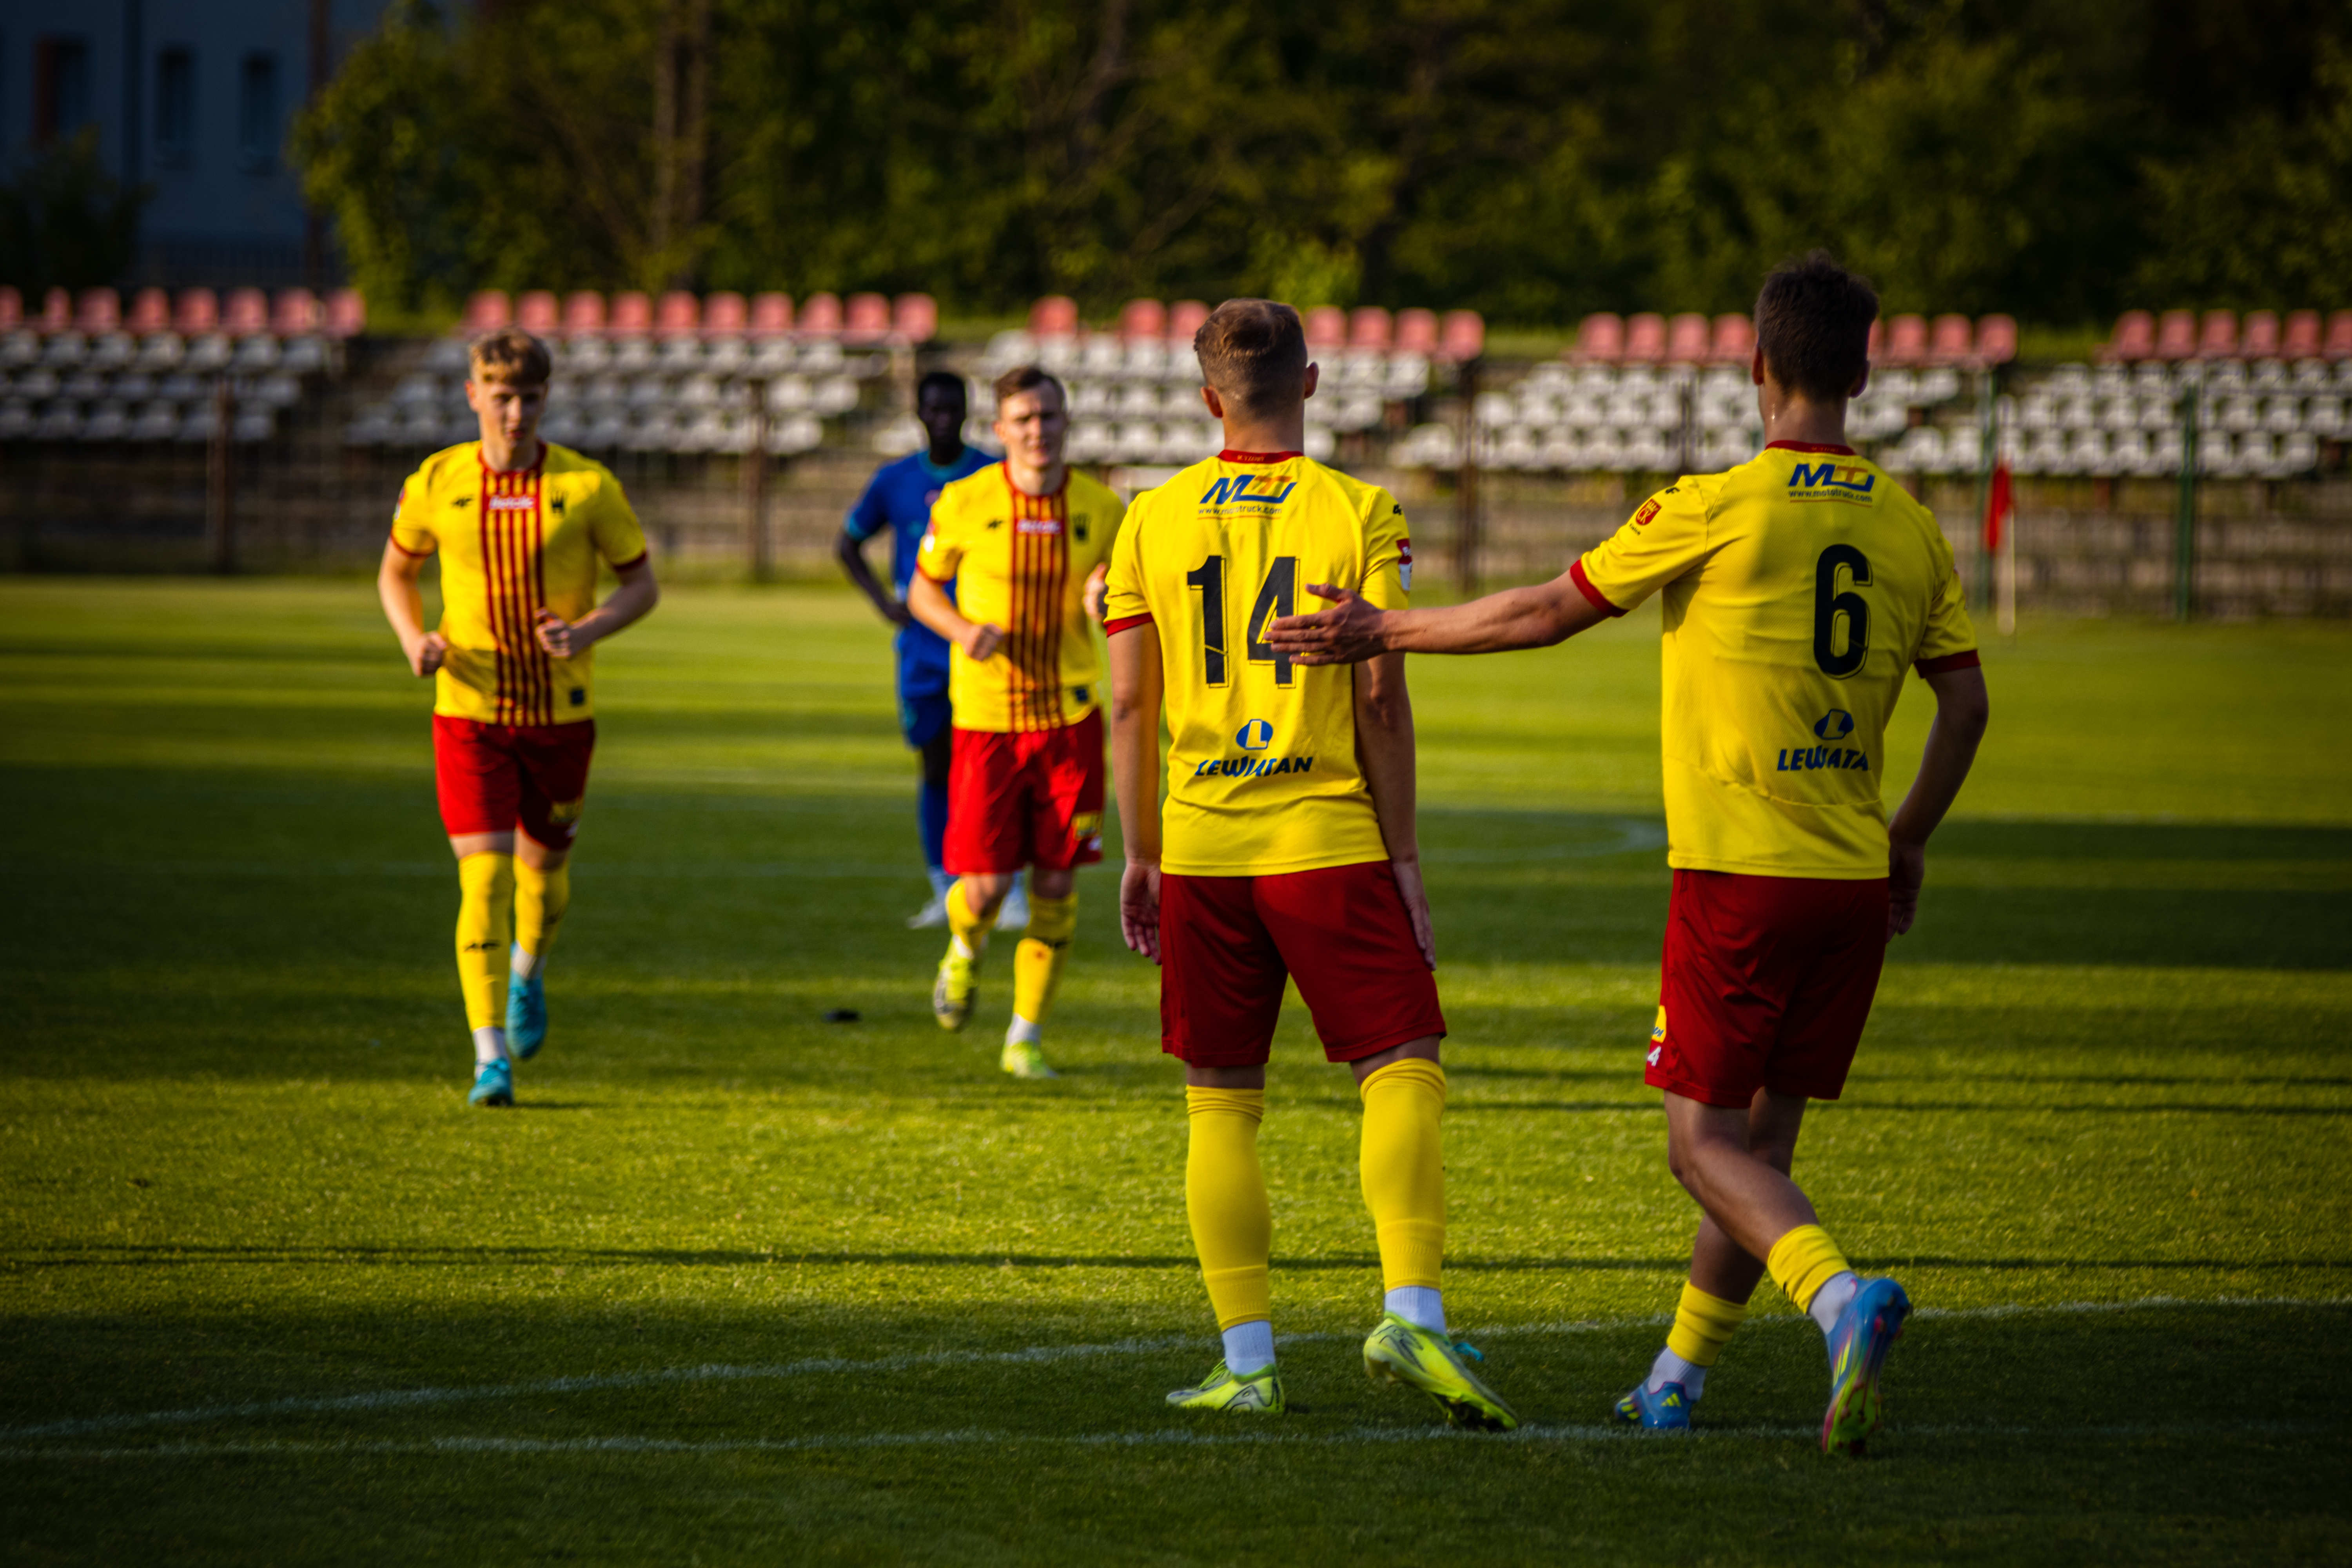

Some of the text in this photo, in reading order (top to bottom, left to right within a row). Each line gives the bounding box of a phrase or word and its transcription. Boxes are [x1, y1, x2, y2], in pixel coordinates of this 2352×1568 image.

[1187, 555, 1299, 689] 14
[1813, 544, 1873, 680] 6
[1194, 755, 1313, 778] LEWIATAN
